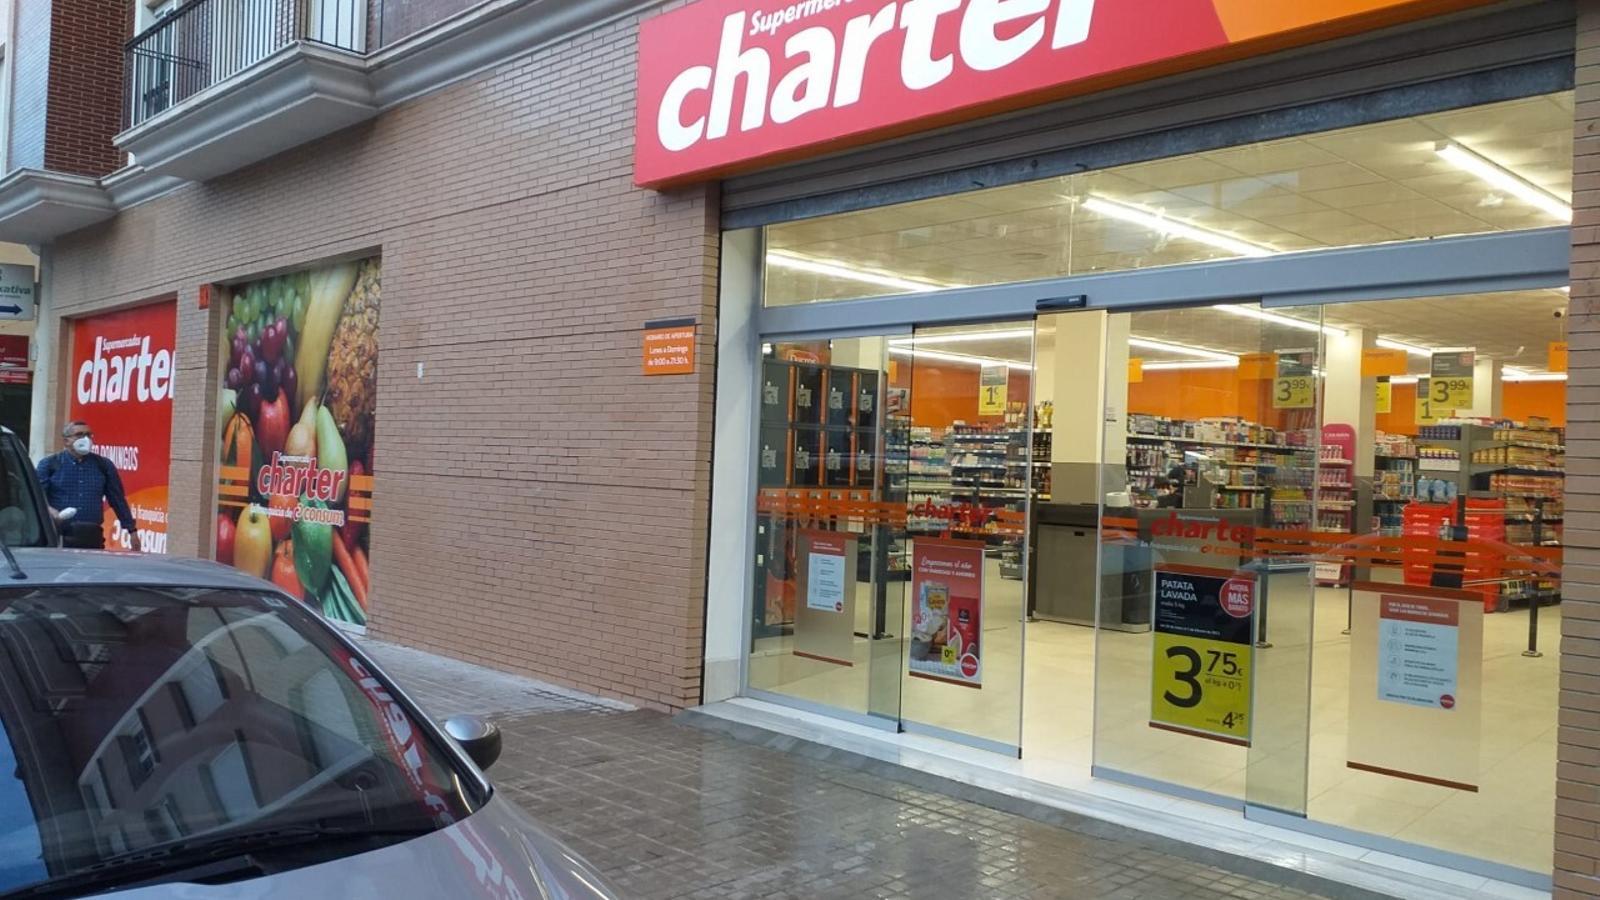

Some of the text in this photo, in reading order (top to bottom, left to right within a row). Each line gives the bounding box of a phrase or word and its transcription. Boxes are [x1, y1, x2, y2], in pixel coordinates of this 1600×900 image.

[257, 451, 344, 501] charter
[1161, 579, 1195, 591] PATATA
[1161, 590, 1198, 602] LAVADA
